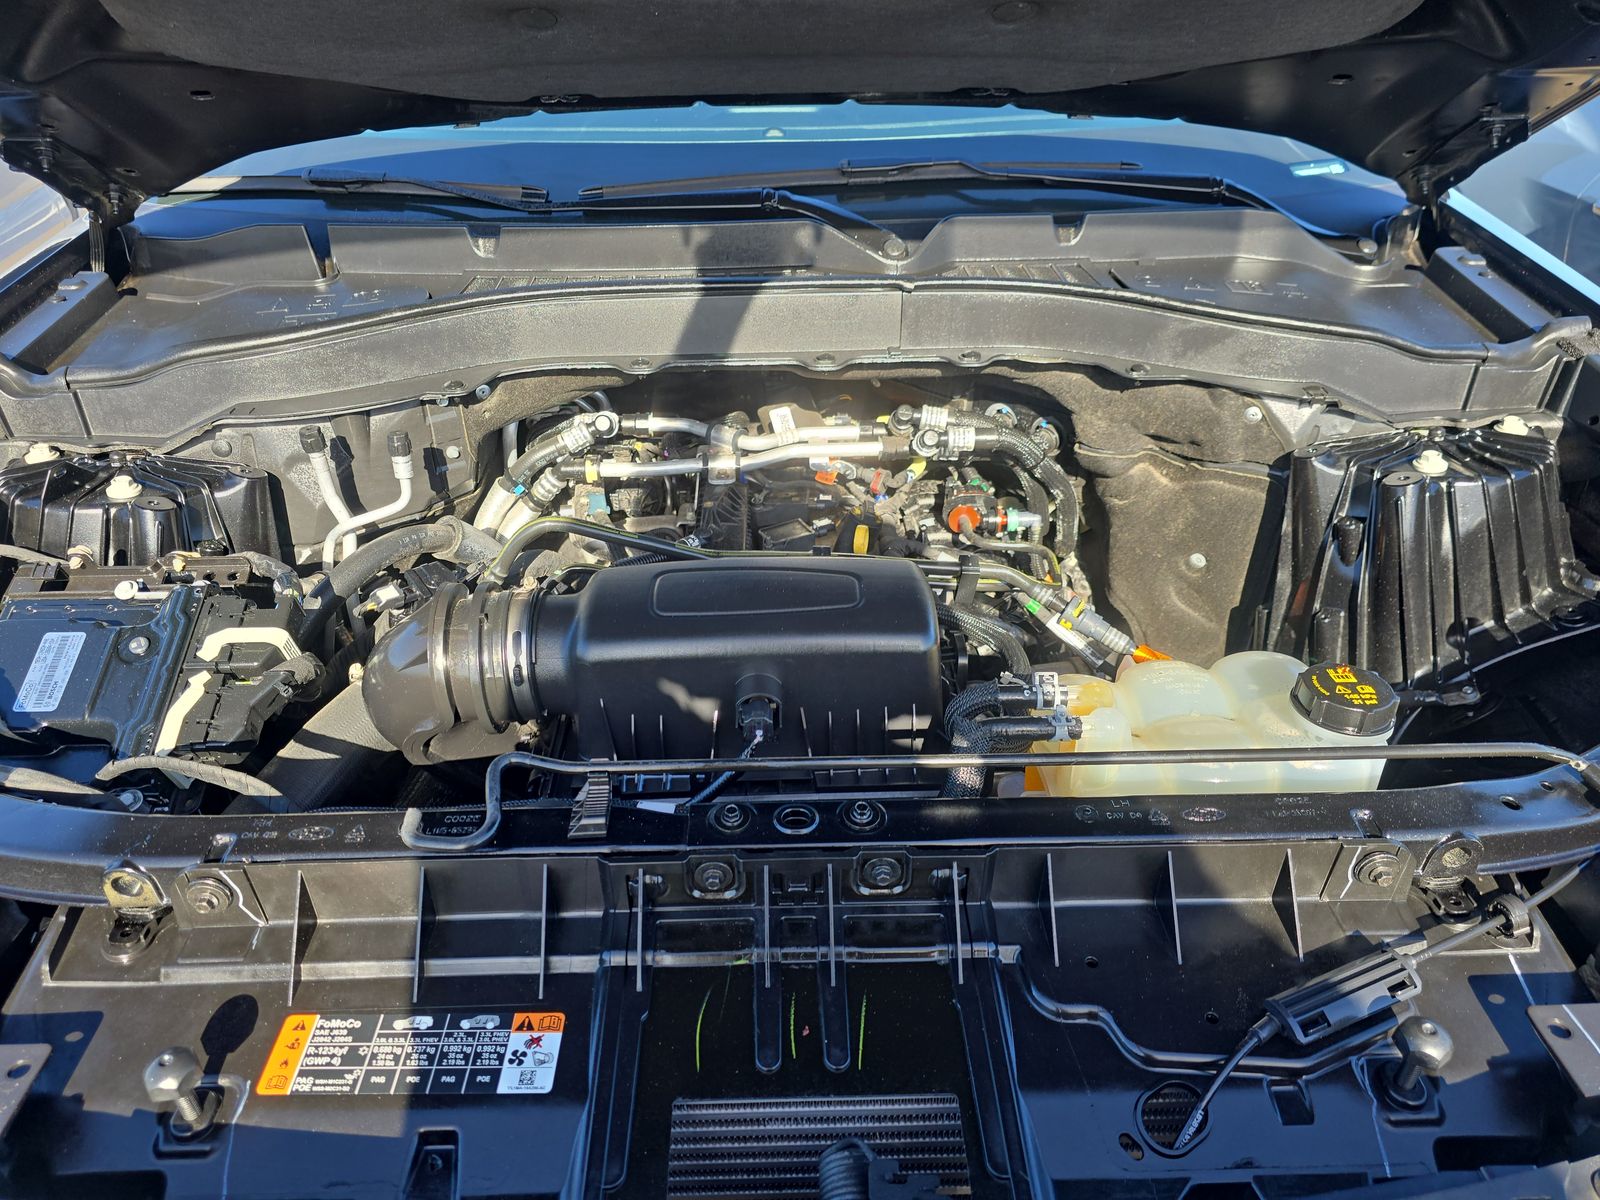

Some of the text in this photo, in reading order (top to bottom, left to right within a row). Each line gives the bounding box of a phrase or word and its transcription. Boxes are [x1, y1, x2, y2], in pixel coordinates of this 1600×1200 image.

[317, 1019, 362, 1029] FoMoCo
[307, 1046, 349, 1056] R-1234yf
[393, 1046, 402, 1055] kg
[427, 1046, 436, 1055] kg
[463, 1045, 472, 1054] kg
[497, 1045, 506, 1054] kg
[303, 1057, 341, 1066] (GWP 4)
